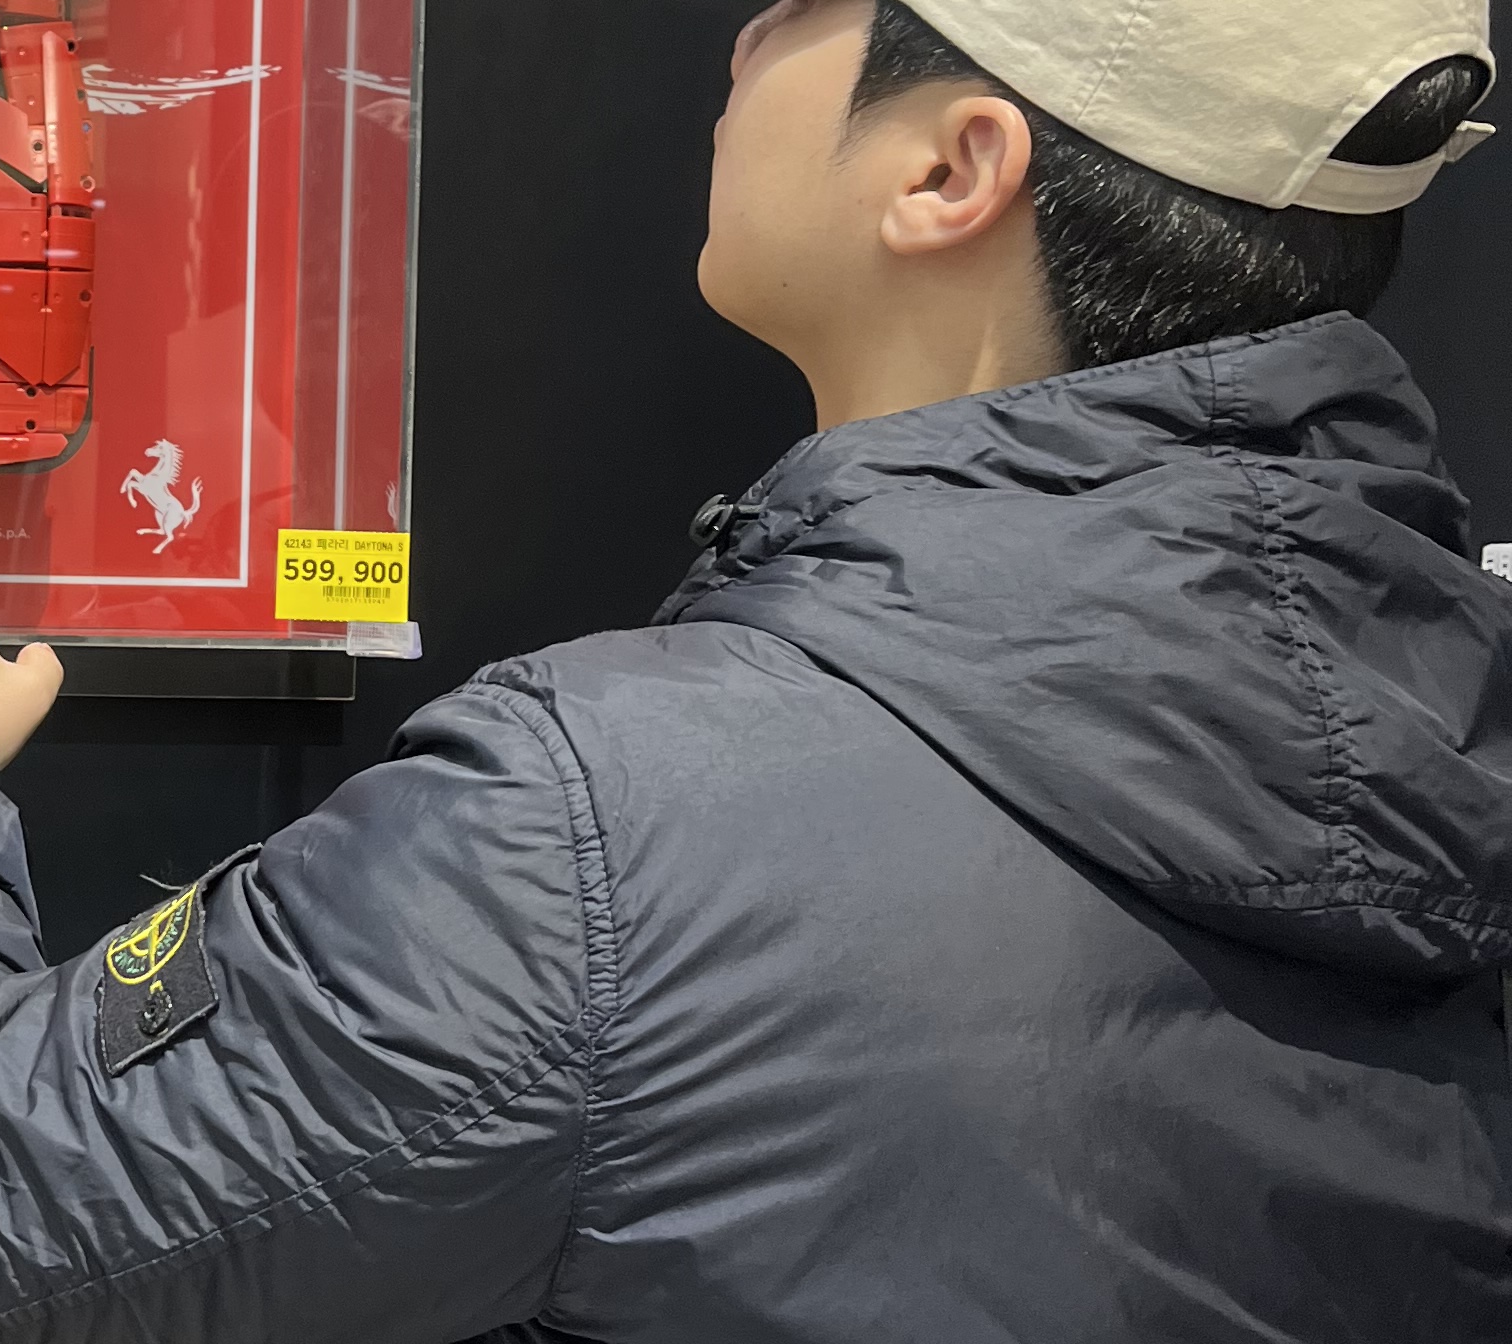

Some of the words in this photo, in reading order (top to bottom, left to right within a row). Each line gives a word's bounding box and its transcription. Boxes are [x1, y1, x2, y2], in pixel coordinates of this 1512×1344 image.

[284, 539, 312, 549] 42143
[354, 540, 393, 552] DAYTONA
[398, 542, 404, 552] S
